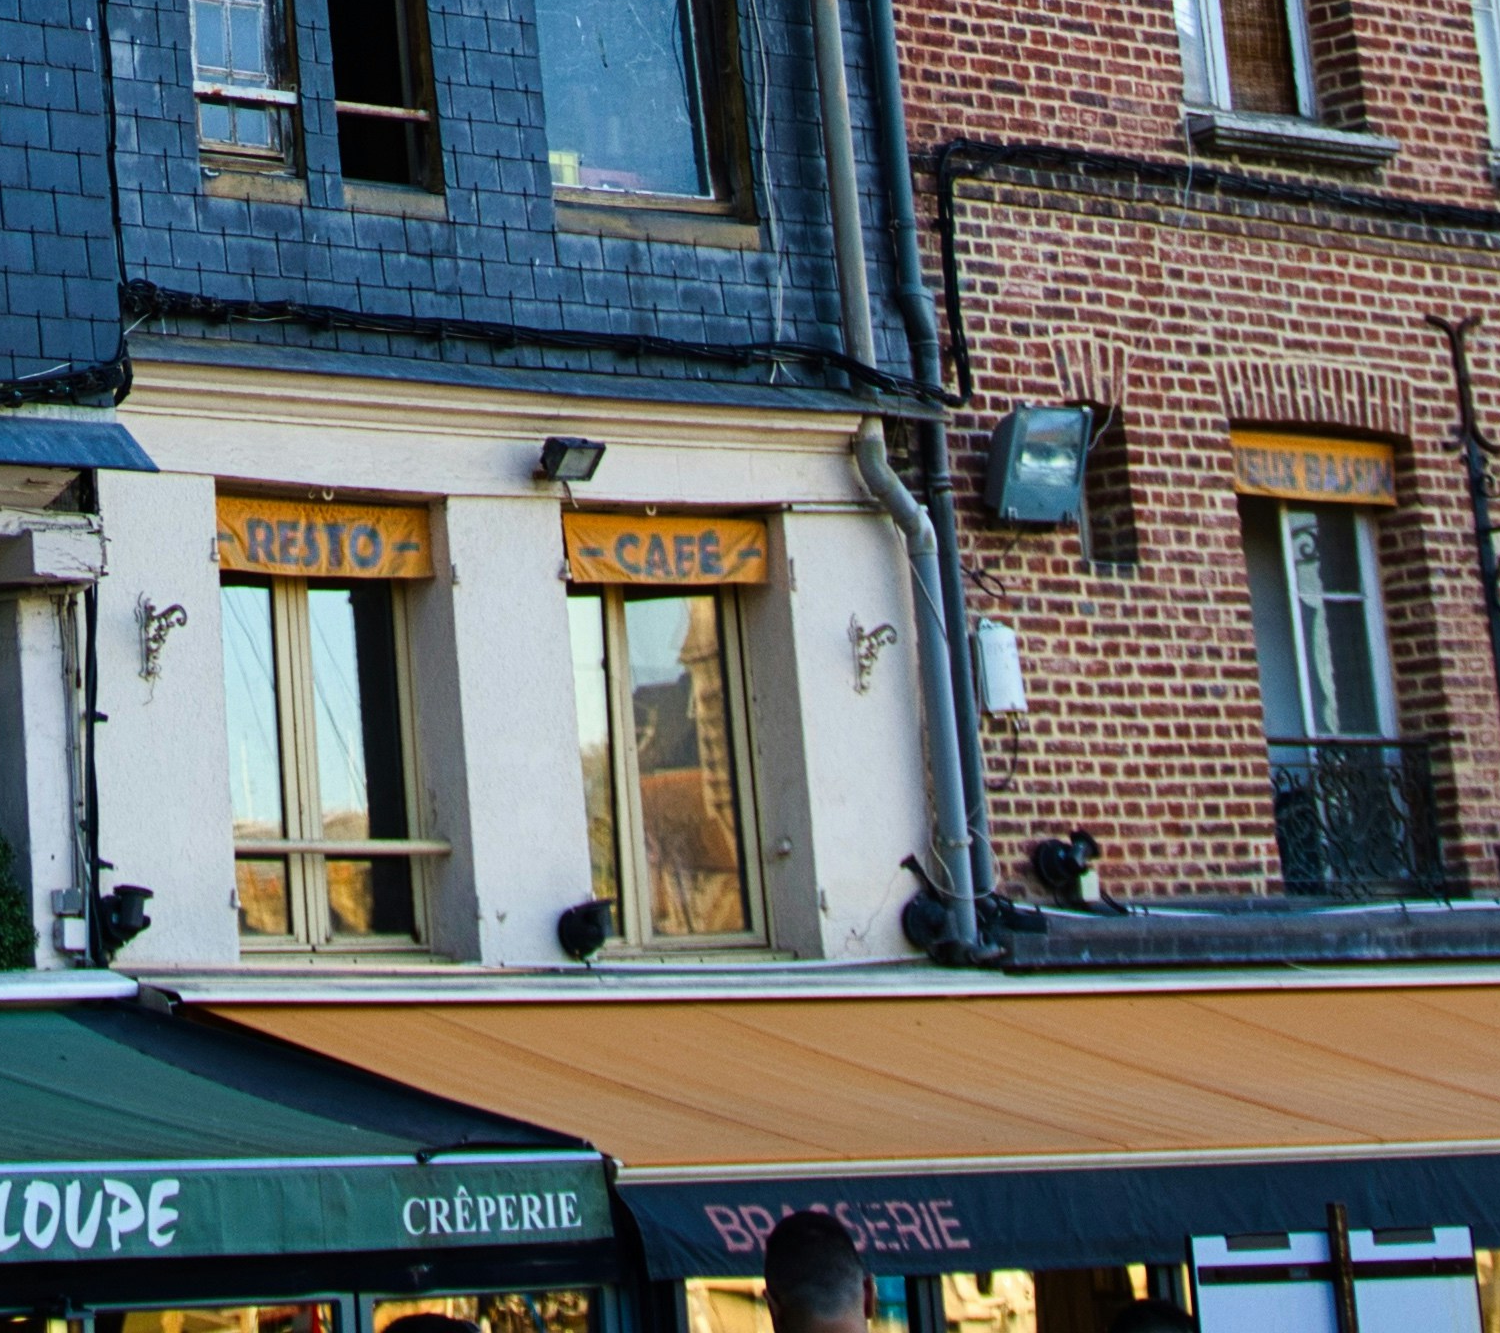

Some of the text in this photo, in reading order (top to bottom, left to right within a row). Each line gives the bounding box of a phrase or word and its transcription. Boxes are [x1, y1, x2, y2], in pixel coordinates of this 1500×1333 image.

[1236, 446, 1297, 490] IEUX
[245, 516, 384, 569] RESTO
[615, 530, 723, 576] CAFÉ
[402, 1185, 583, 1237] CRÊPERIE
[703, 1199, 971, 1253] BRSERIE
